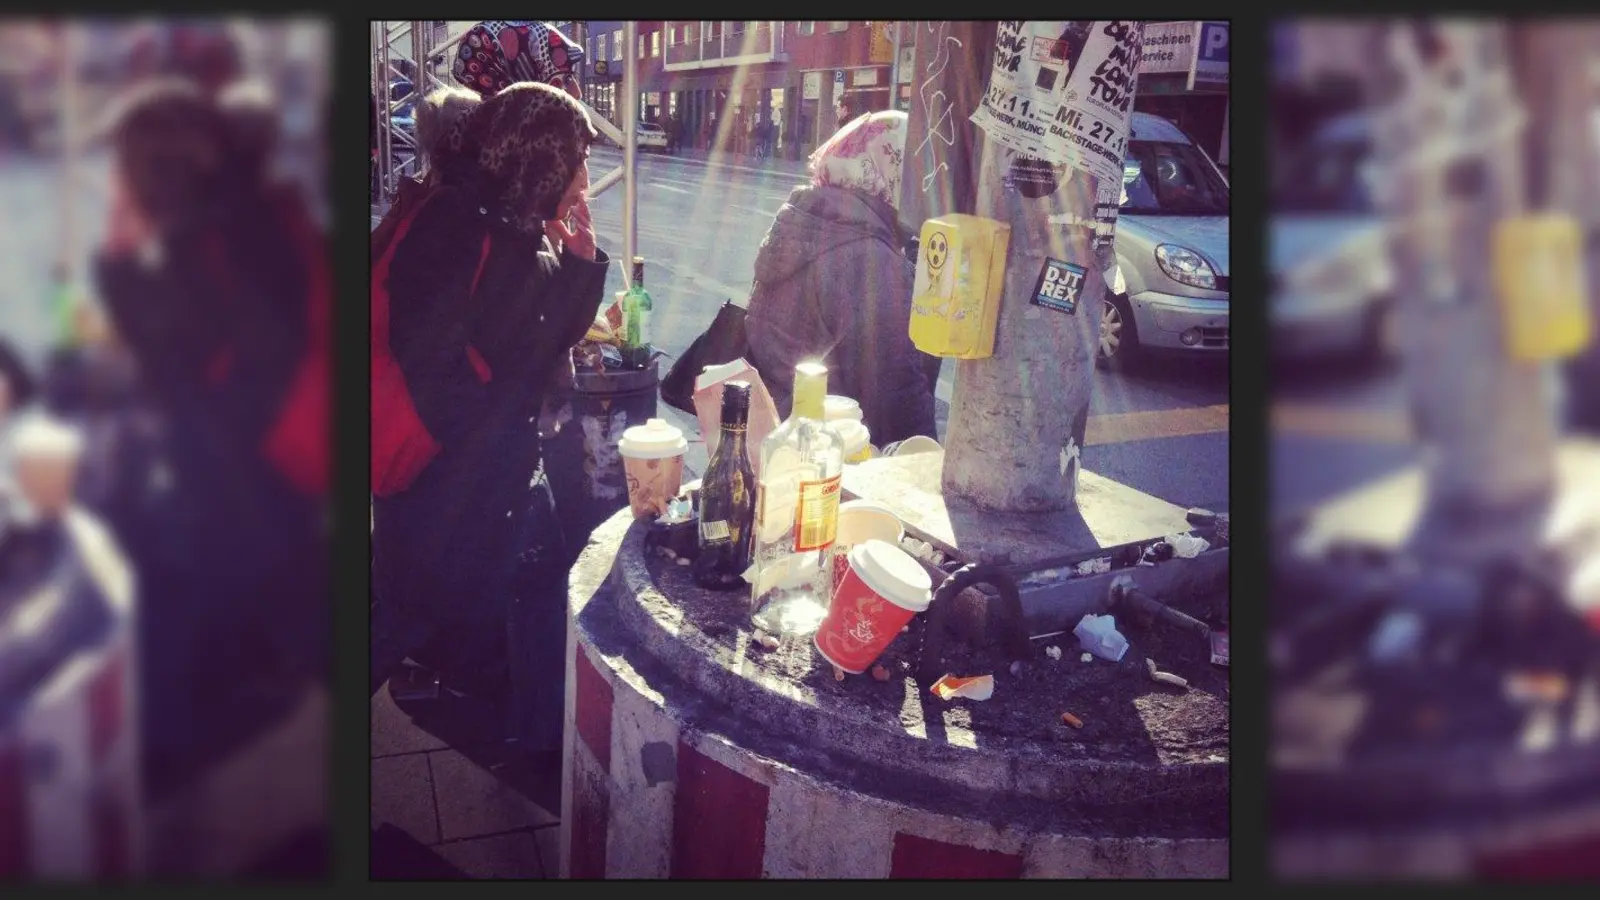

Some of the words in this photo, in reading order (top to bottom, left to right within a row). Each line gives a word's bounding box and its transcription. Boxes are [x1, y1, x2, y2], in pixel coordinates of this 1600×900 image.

[1143, 32, 1191, 46] aschinen
[1205, 26, 1228, 57] P
[1142, 49, 1174, 61] ervice
[1055, 104, 1084, 131] Mi.
[1040, 280, 1077, 303] REX
